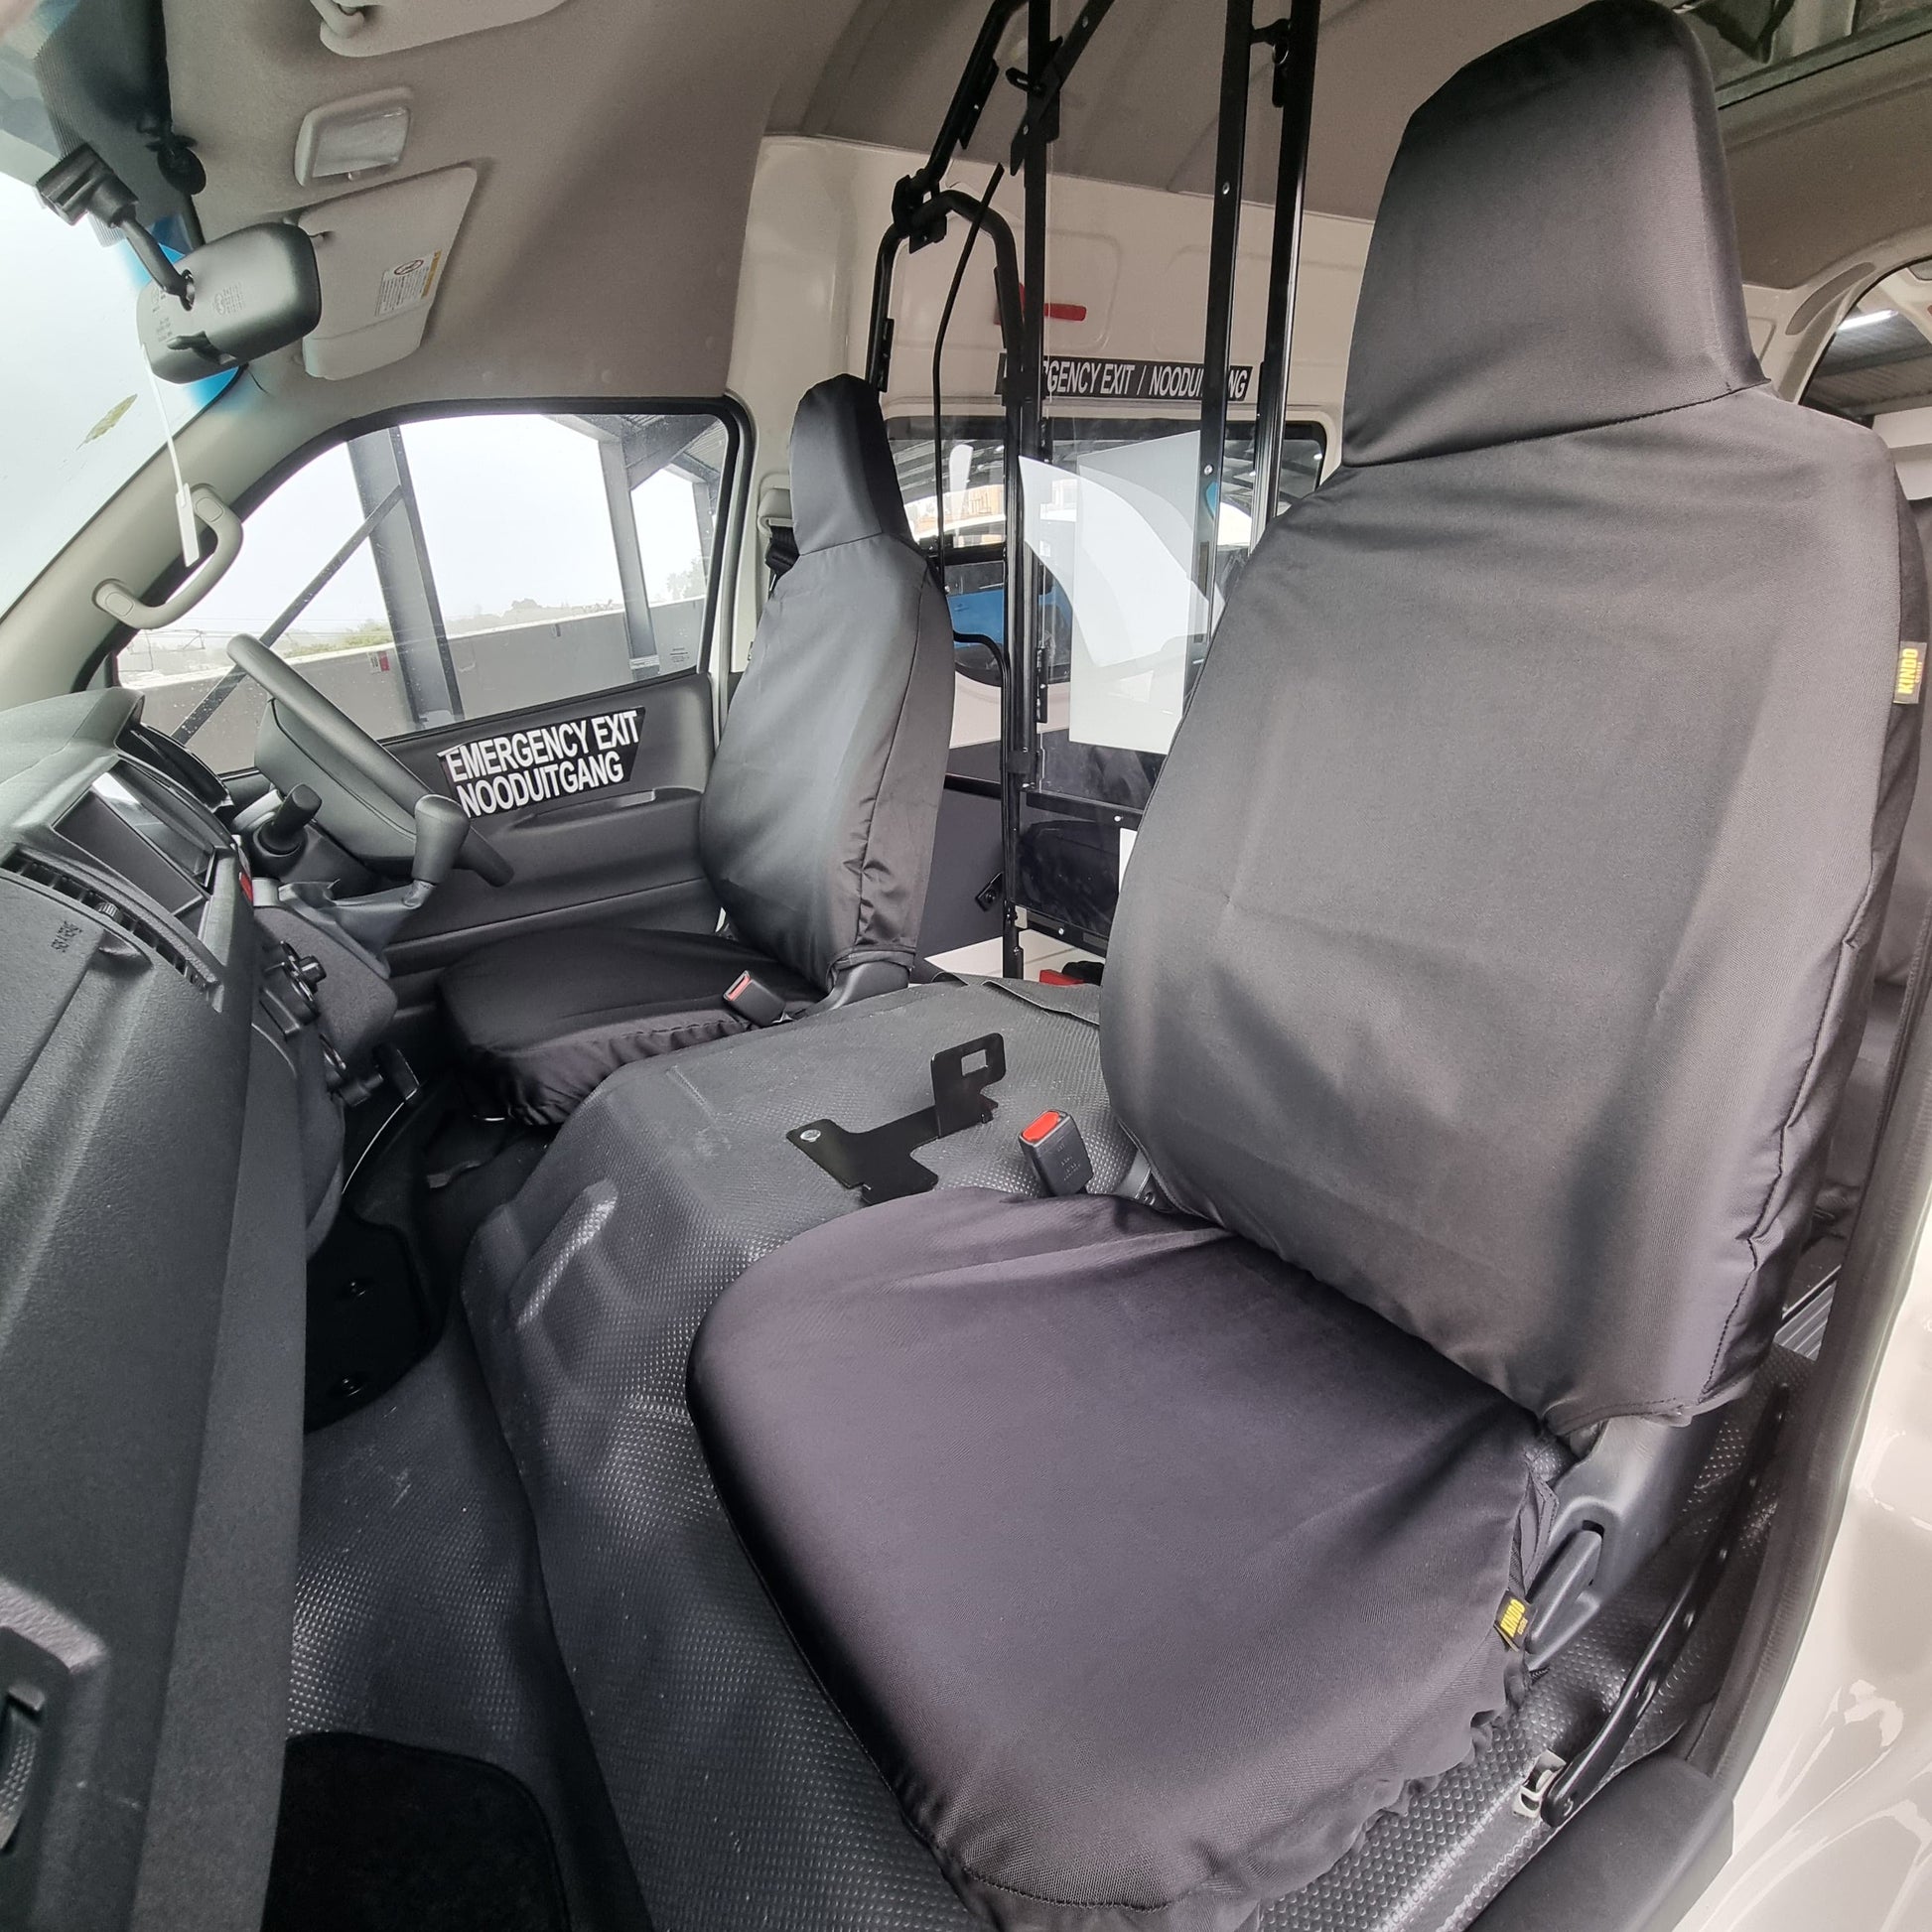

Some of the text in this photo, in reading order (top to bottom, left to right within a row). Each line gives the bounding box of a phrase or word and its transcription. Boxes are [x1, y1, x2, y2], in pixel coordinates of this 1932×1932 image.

[1041, 360, 1248, 398] GENCY EXIT / NOODUING
[1898, 648, 1918, 694] KINDO
[446, 710, 639, 782] EMERGENCY EXIT
[456, 752, 624, 818] NOODUITGANG
[1500, 1599, 1525, 1638] KINDO
